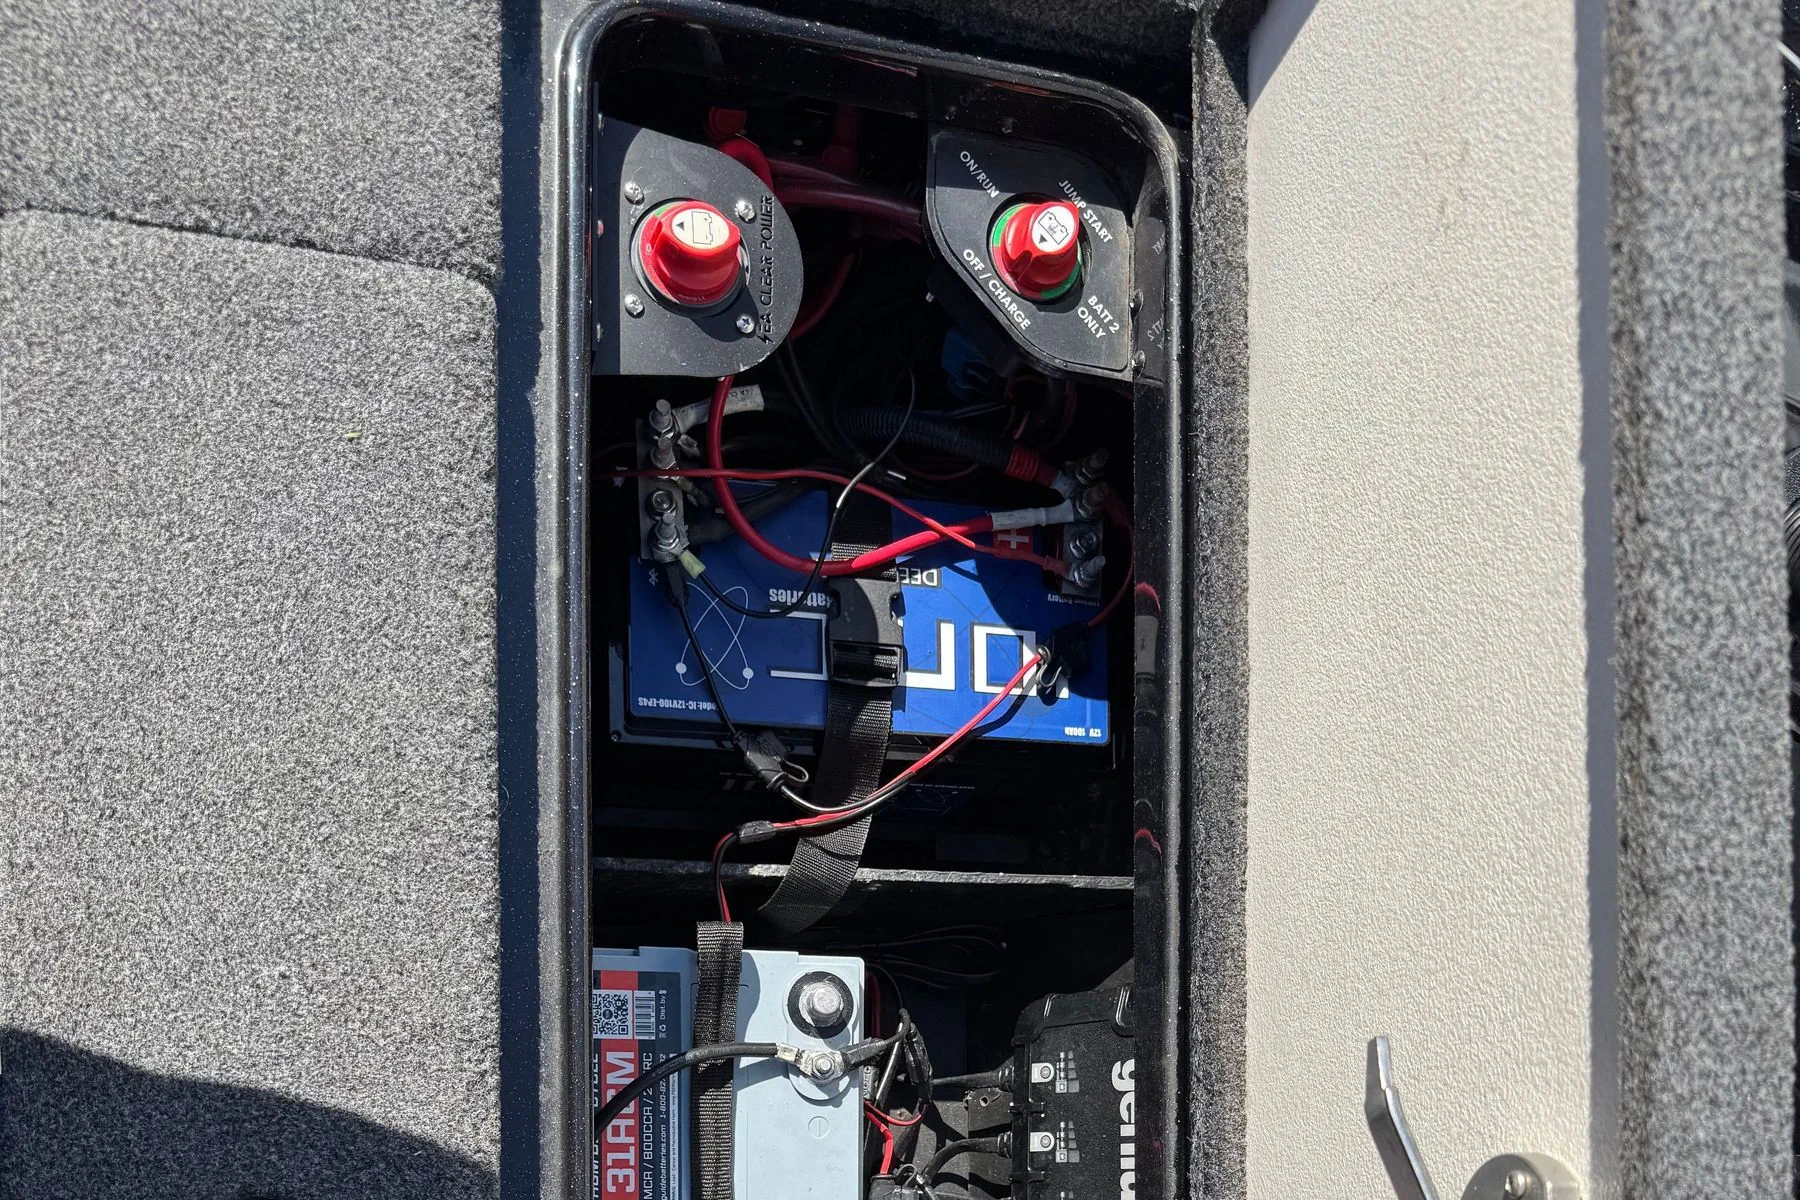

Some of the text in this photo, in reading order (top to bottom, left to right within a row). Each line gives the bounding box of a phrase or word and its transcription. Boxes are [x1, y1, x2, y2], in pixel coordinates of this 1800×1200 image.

[959, 149, 1000, 198] ON/RUN
[760, 195, 775, 251] POWER
[1058, 180, 1113, 244] JUMP START
[760, 255, 774, 306] CLEAR
[962, 248, 986, 272] OFF
[988, 279, 1032, 331] CHARGE
[1076, 306, 1107, 340] ONLY
[1087, 295, 1121, 334] BATT 2
[1048, 593, 1073, 606] Battery
[697, 700, 718, 712] odel:
[1089, 728, 1102, 738] 12V
